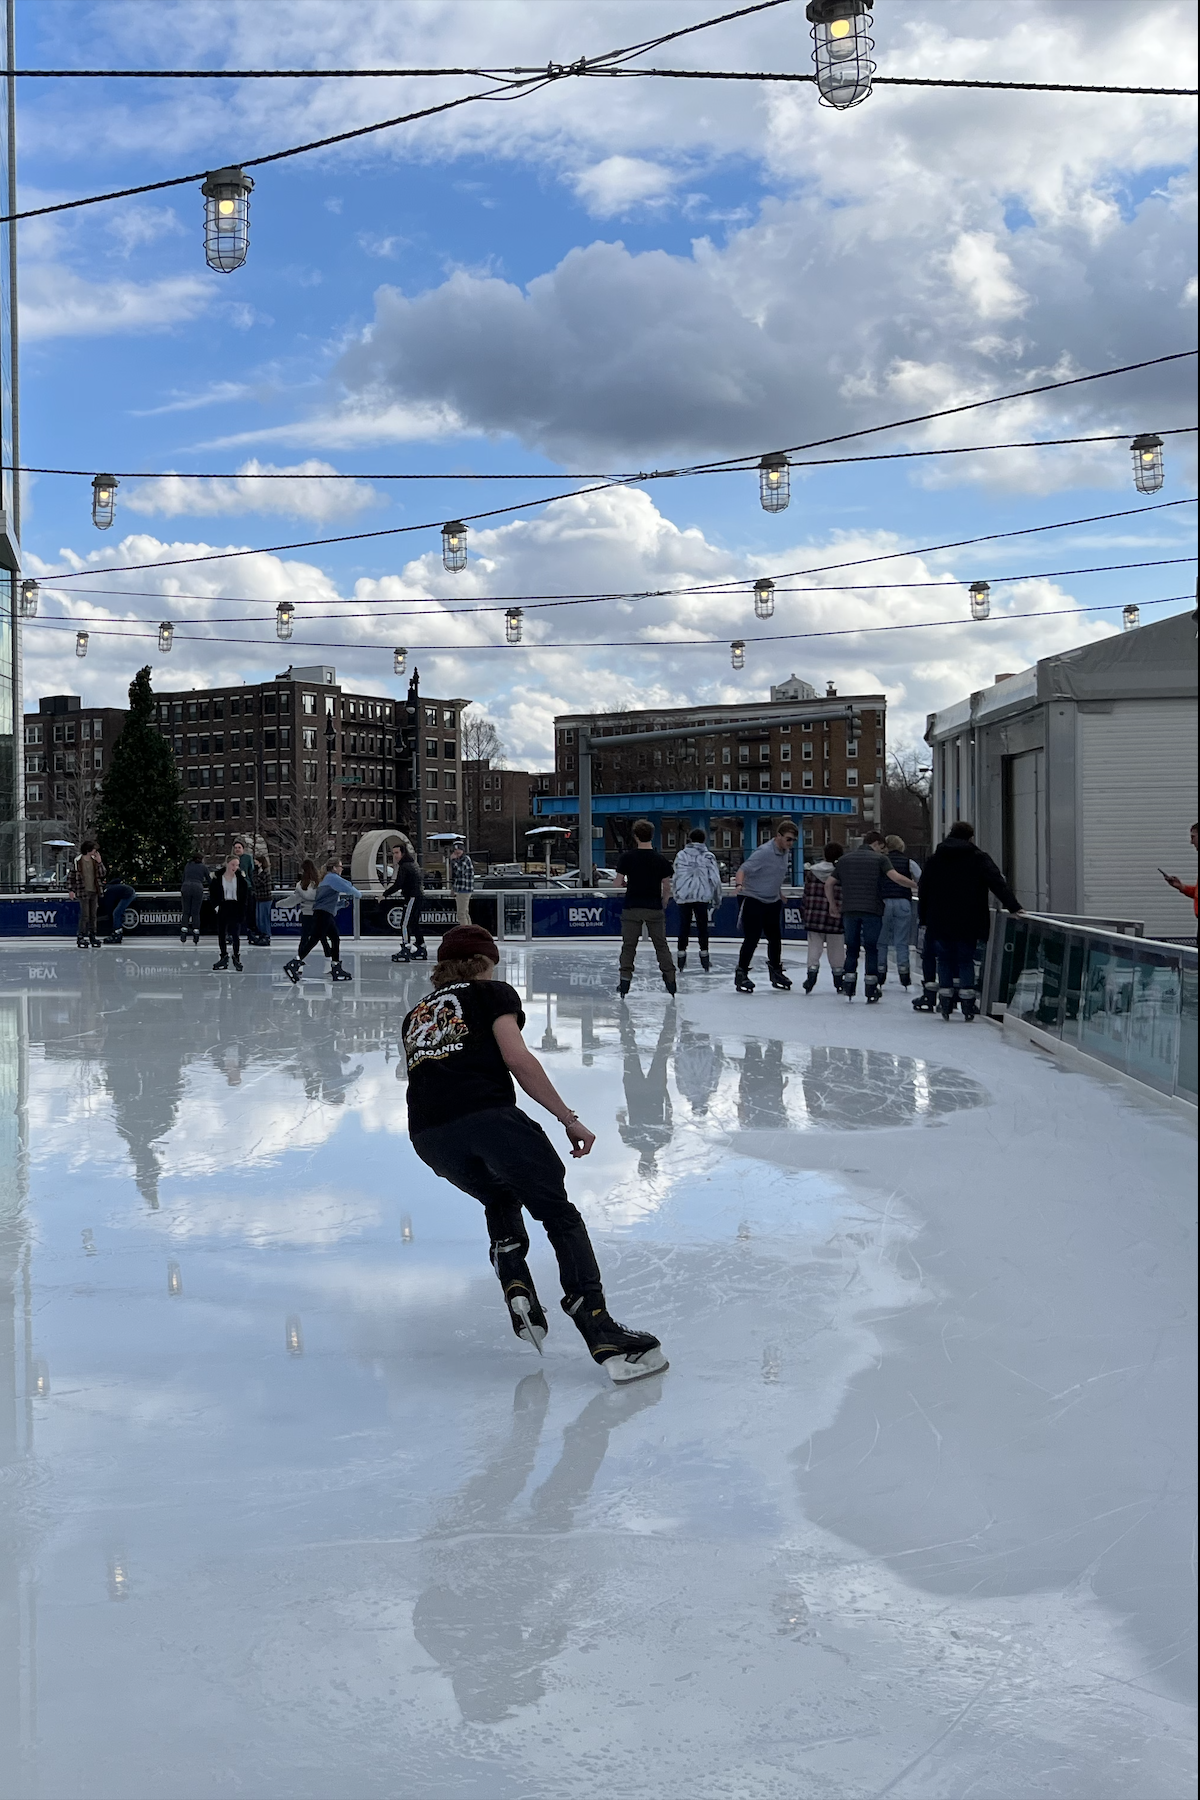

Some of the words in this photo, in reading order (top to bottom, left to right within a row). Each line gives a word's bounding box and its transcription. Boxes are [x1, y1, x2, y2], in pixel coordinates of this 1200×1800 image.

[28, 911, 57, 923] BEVY
[140, 914, 193, 923] FOUNDATI
[271, 909, 301, 921] BEVY
[419, 913, 460, 922] UNDATI
[569, 908, 603, 921] BEVY
[784, 908, 802, 923] BEV
[413, 1043, 464, 1061] ORGANIC
